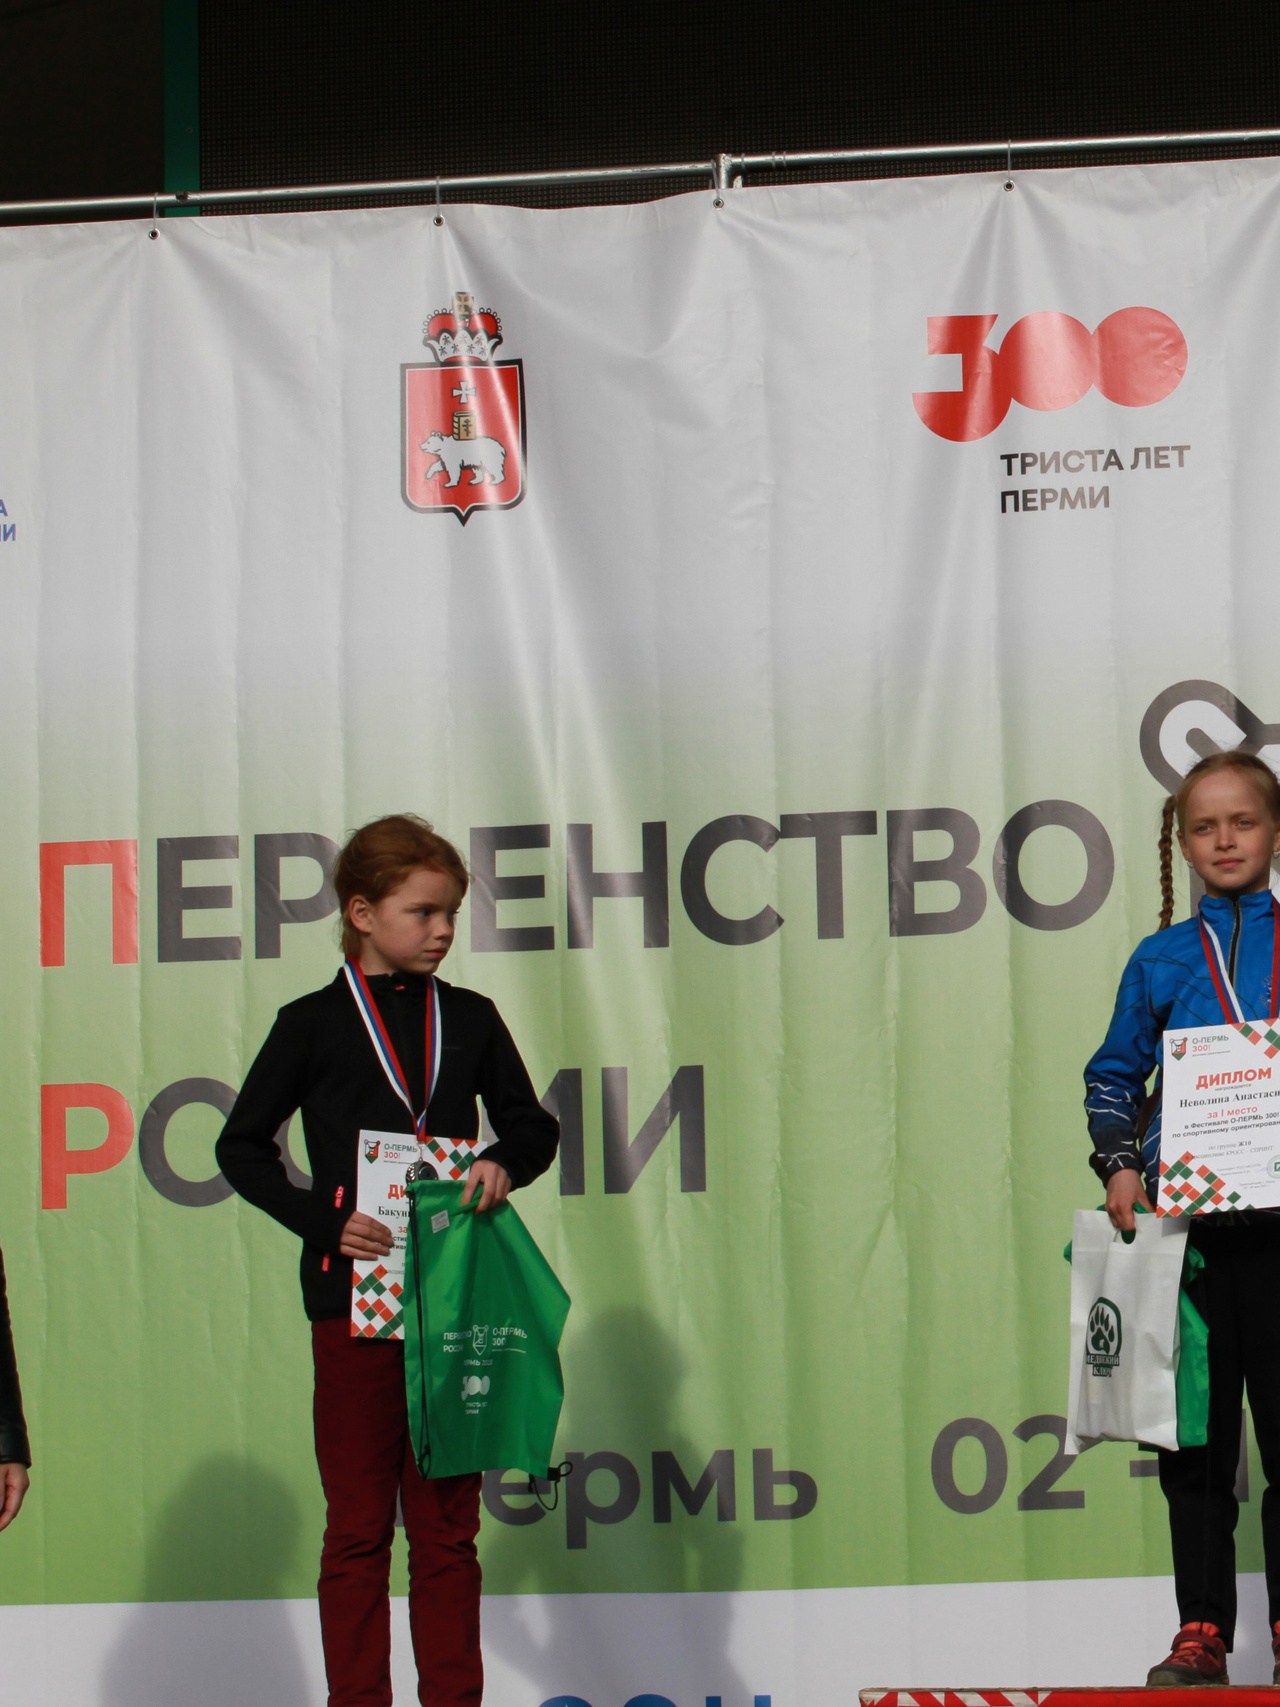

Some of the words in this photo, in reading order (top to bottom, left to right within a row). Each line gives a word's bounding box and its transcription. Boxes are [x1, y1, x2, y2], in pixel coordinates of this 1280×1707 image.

[1000, 449, 1124, 477] ТРИСТА
[1130, 445, 1191, 472] ЛЕТ
[1000, 485, 1110, 513] ПЕРМИ
[39, 799, 1115, 968] ПЕРЕНСТВО
[1191, 1035, 1229, 1045] О-ПЕРМЬ
[1195, 1067, 1272, 1090] ДИПЛОМ
[1179, 1096, 1230, 1109] Неволина
[1207, 1112, 1218, 1120] за
[1227, 1106, 1258, 1117] место
[1190, 1119, 1228, 1130] Фестивале
[1230, 1115, 1263, 1124] О-ПЕРМЬ
[1183, 1126, 1229, 1138] спортивному
[384, 1143, 418, 1153] О-ПЕРМЬ
[378, 1206, 411, 1219] Бакун
[395, 1448, 818, 1549] ермь
[931, 1414, 1086, 1515] 02
